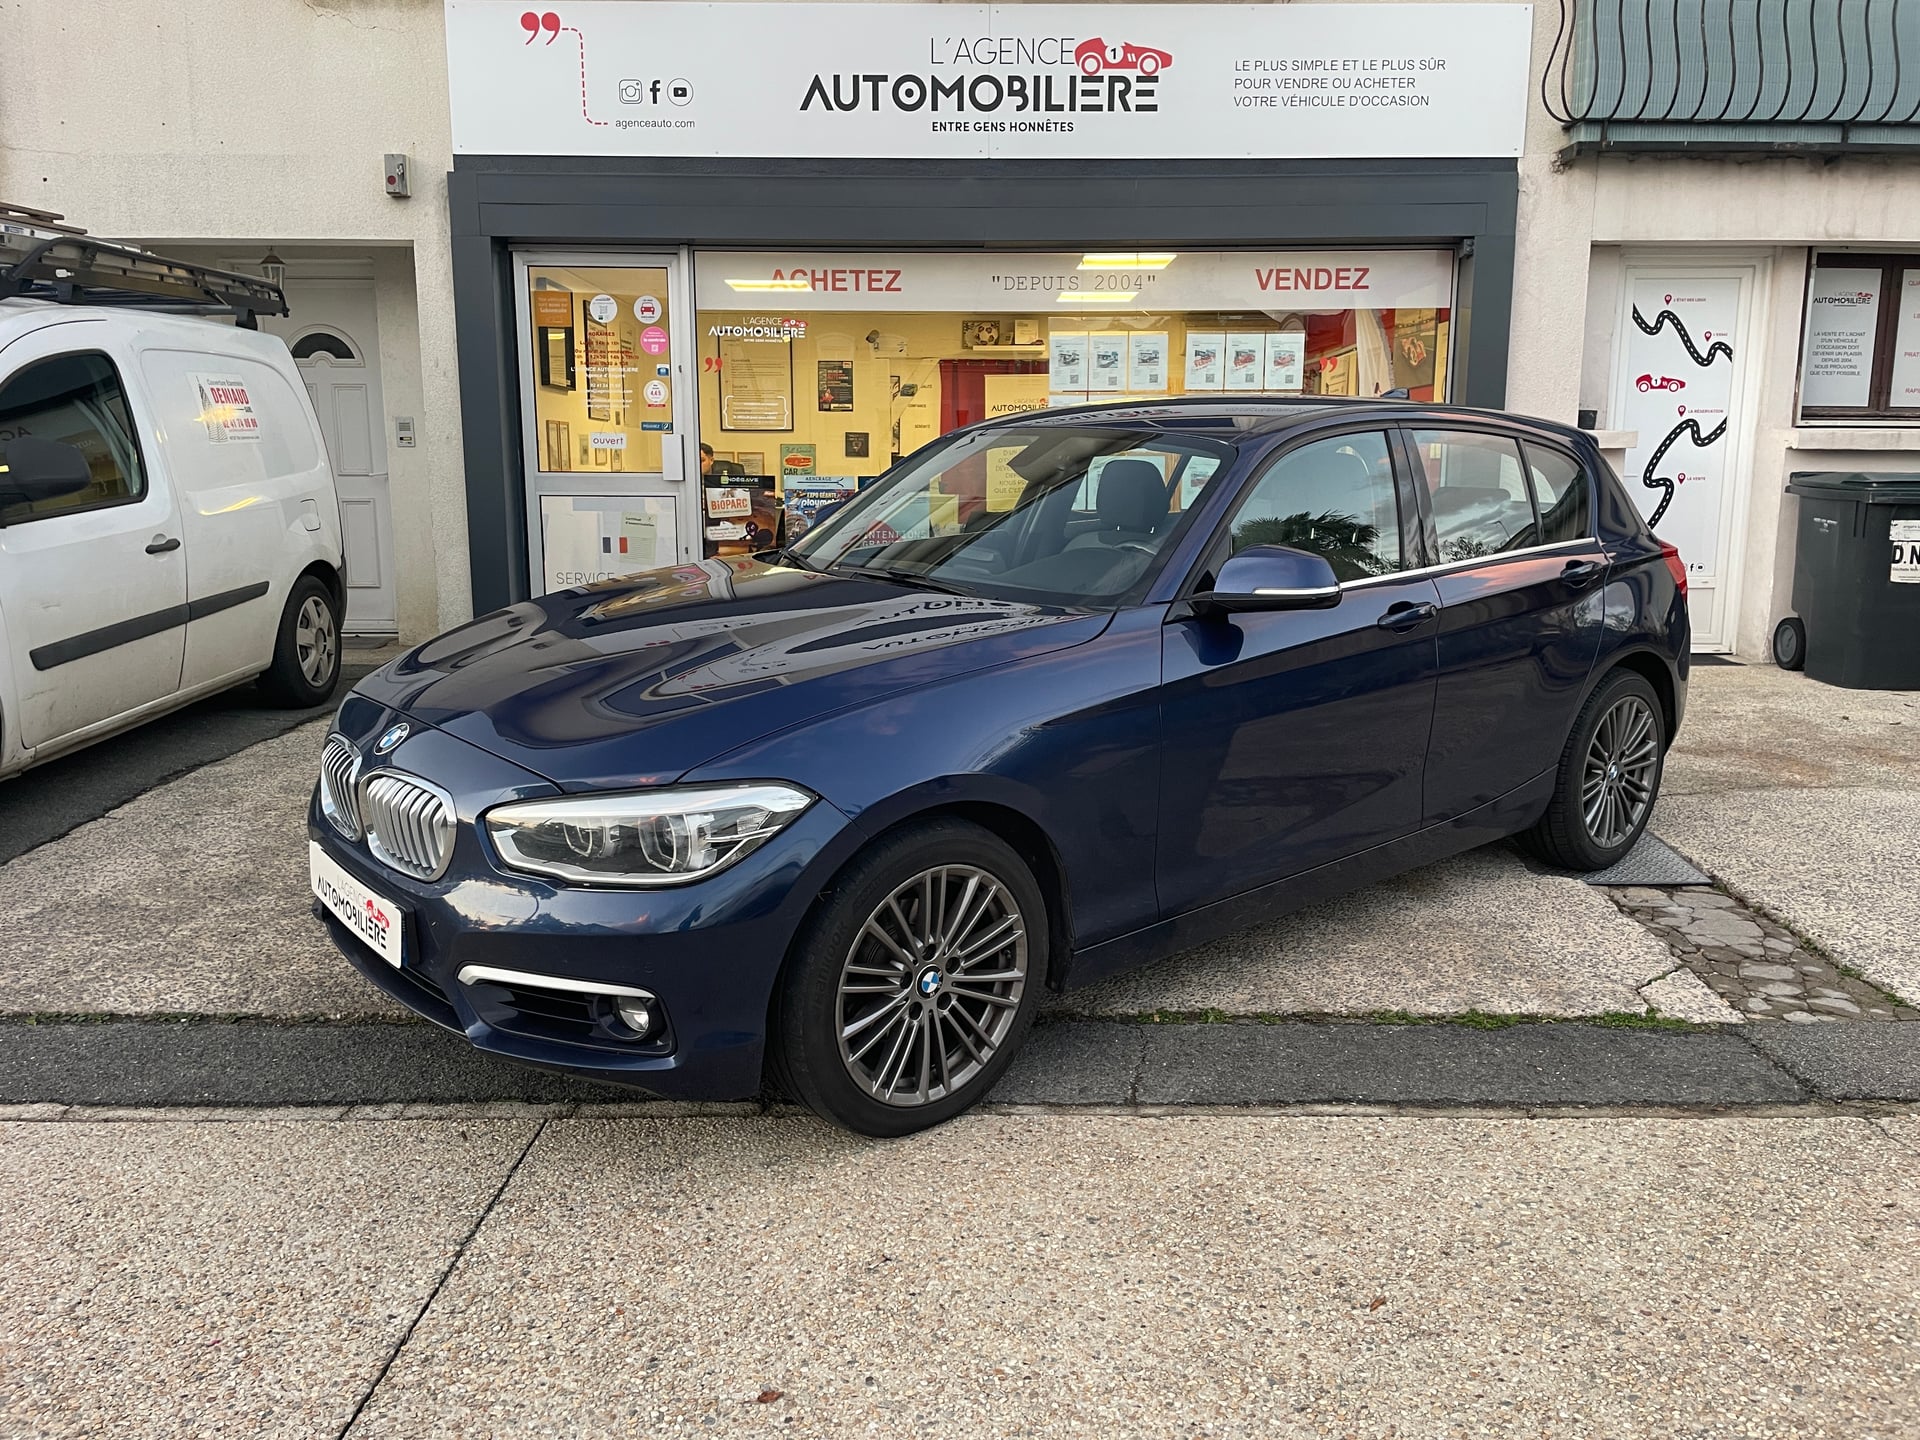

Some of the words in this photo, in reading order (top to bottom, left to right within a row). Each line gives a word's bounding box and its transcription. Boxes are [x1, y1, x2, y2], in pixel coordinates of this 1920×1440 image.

[930, 37, 1075, 66] L'AGENCE
[1236, 61, 1250, 71] LE
[1255, 60, 1287, 71] PLUS
[1292, 60, 1338, 71] SIMPLE
[1343, 60, 1359, 70] ET
[1363, 60, 1377, 70] LE
[1382, 60, 1414, 70] PLUS
[1419, 57, 1445, 70] SÛR
[1235, 79, 1266, 89] POUR
[1266, 78, 1328, 88] VENDRE
[1333, 78, 1351, 88] OU
[1354, 78, 1415, 88] ACHETER
[1234, 96, 1277, 107] VOTRE
[1282, 94, 1345, 106] VÉHICULE
[1350, 95, 1429, 106] D'OCCASION
[616, 120, 695, 129] agenceauto.com
[932, 122, 969, 131] ENTRE
[974, 122, 1005, 132] GENS
[1010, 119, 1073, 132] HONNÊTES
[771, 269, 902, 291] ACHETEZ
[1256, 268, 1370, 290] VENDEZ
[743, 317, 782, 325] L'AGENCE
[210, 388, 249, 404] DENIAUD
